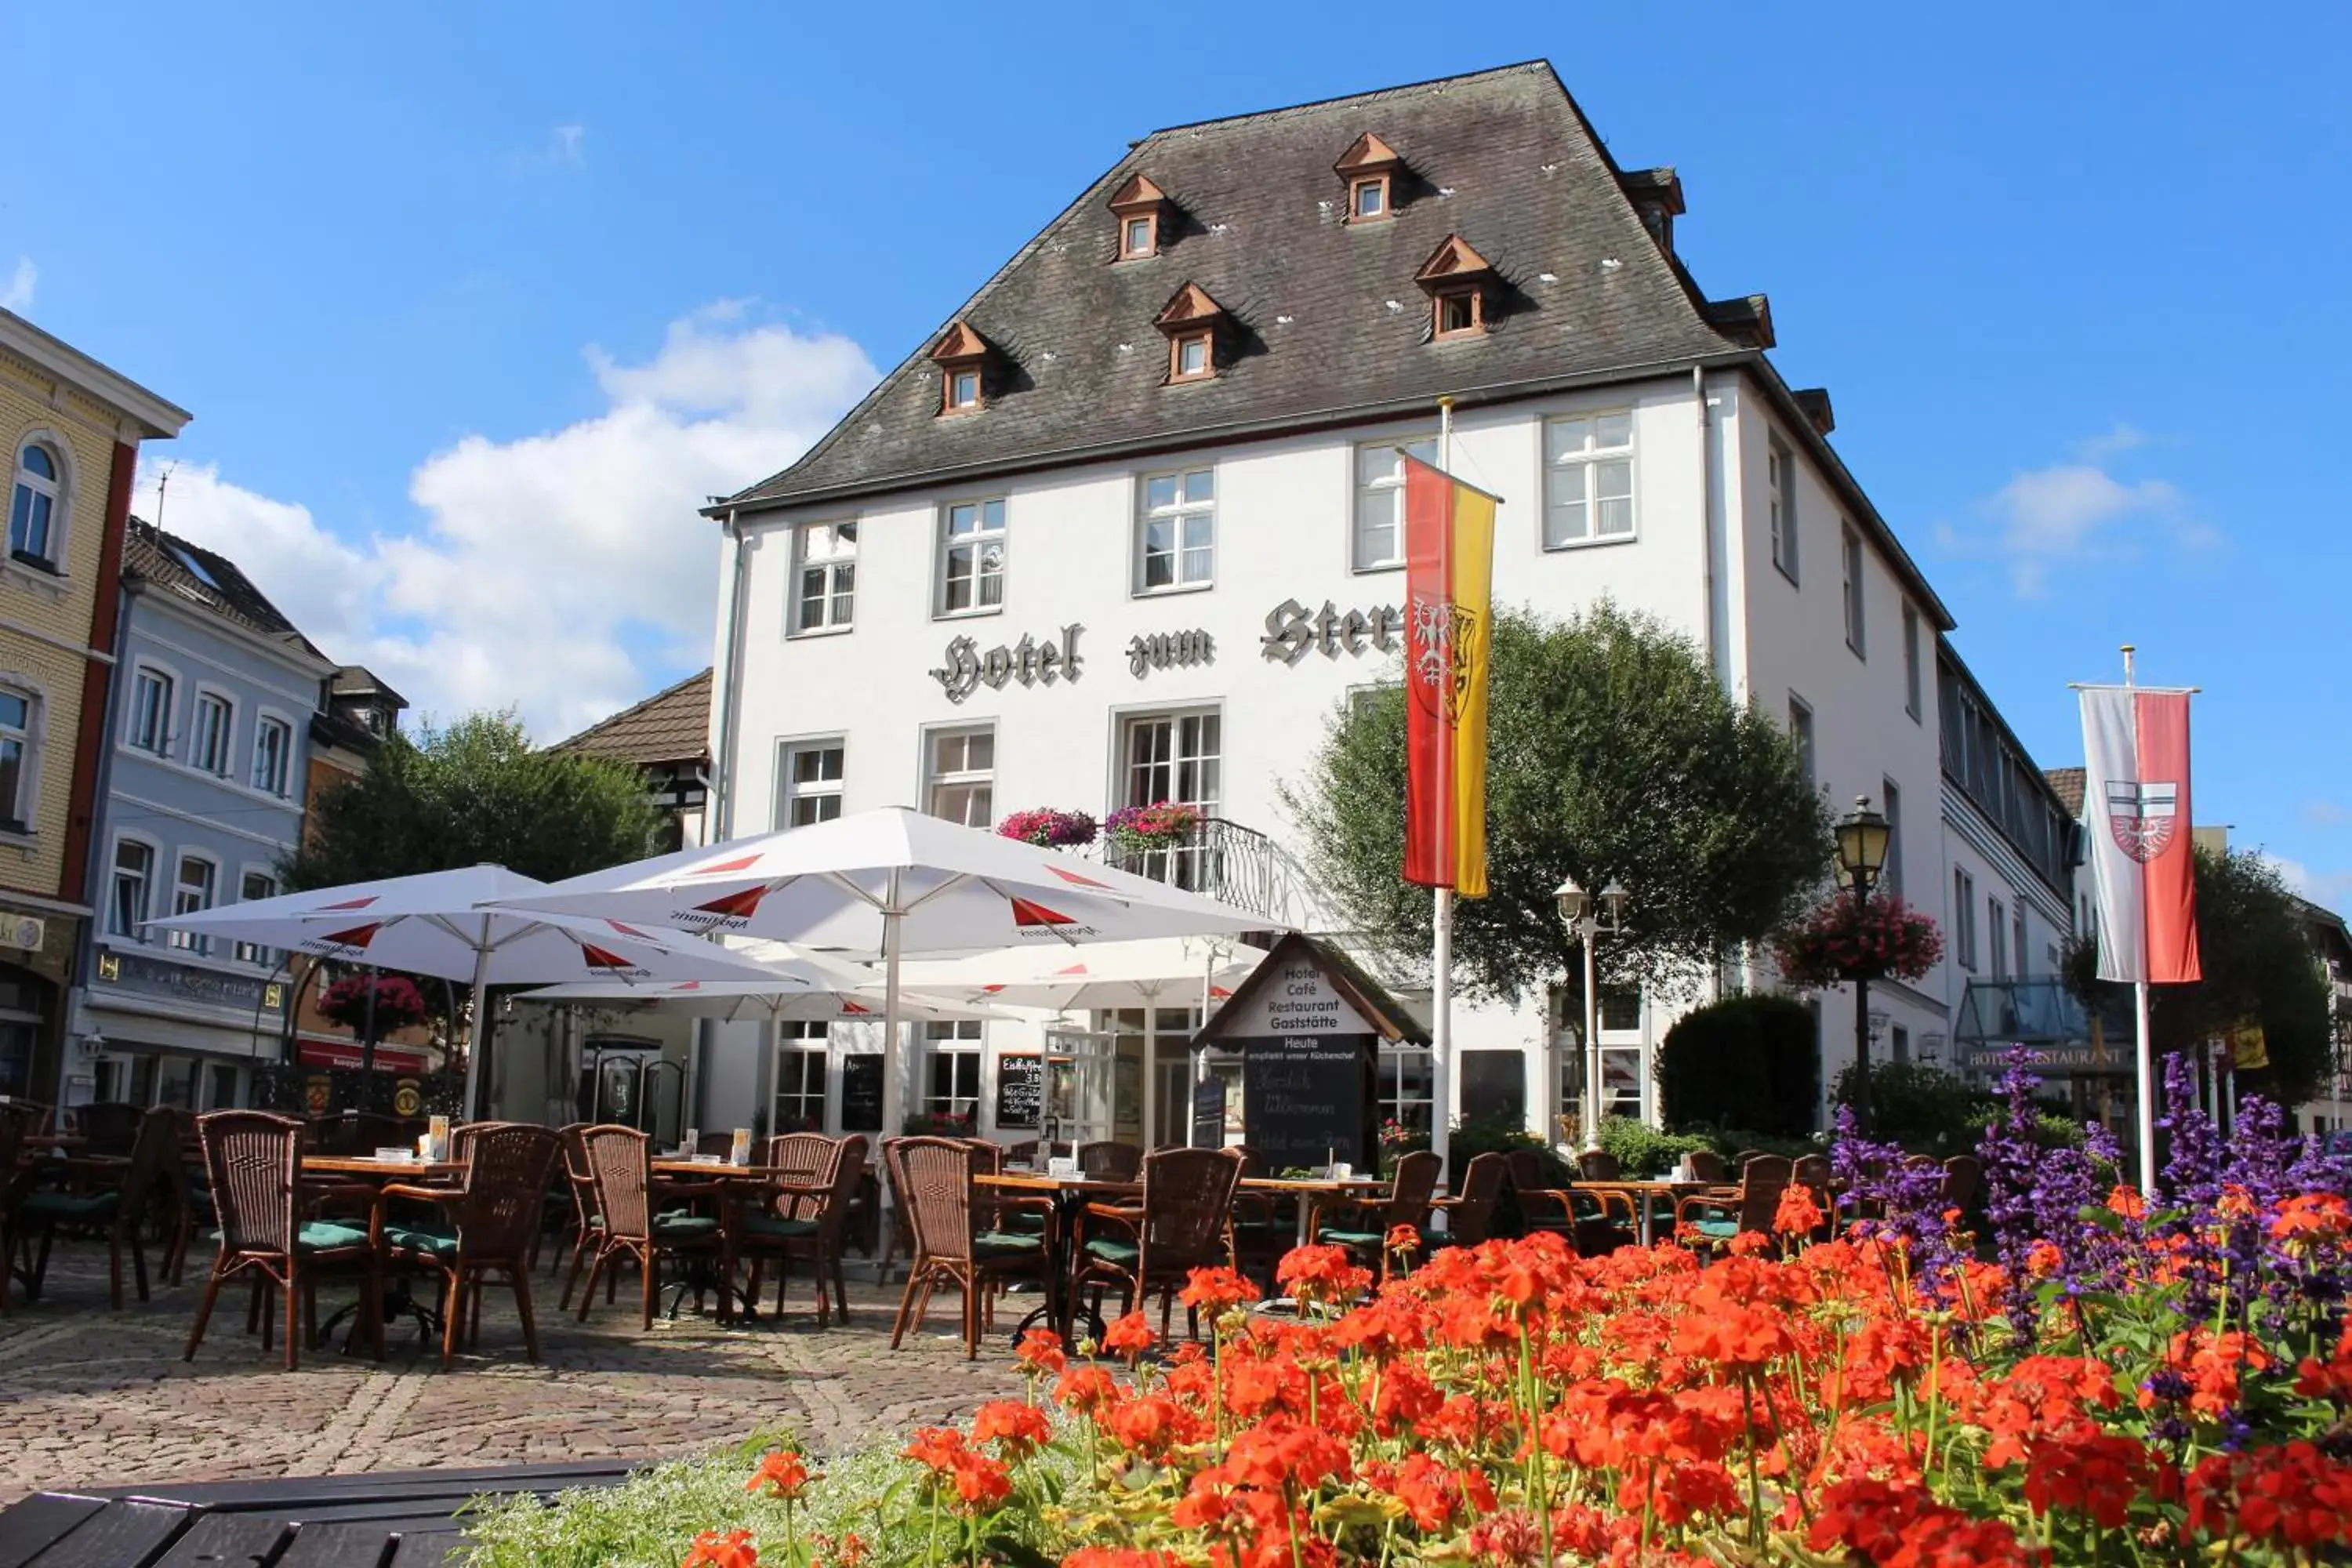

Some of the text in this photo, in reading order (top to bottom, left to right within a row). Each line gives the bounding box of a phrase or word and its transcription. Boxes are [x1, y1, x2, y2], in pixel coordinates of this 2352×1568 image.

[930, 597, 1406, 706] Hotel zum Ster
[1285, 967, 1319, 979] Hotel
[1287, 982, 1316, 996] Café
[1268, 999, 1340, 1013] Restaurant
[1270, 1015, 1338, 1029] Gaststätte
[1285, 1037, 1319, 1048] Heute
[1970, 1052, 2012, 1066] HOTE
